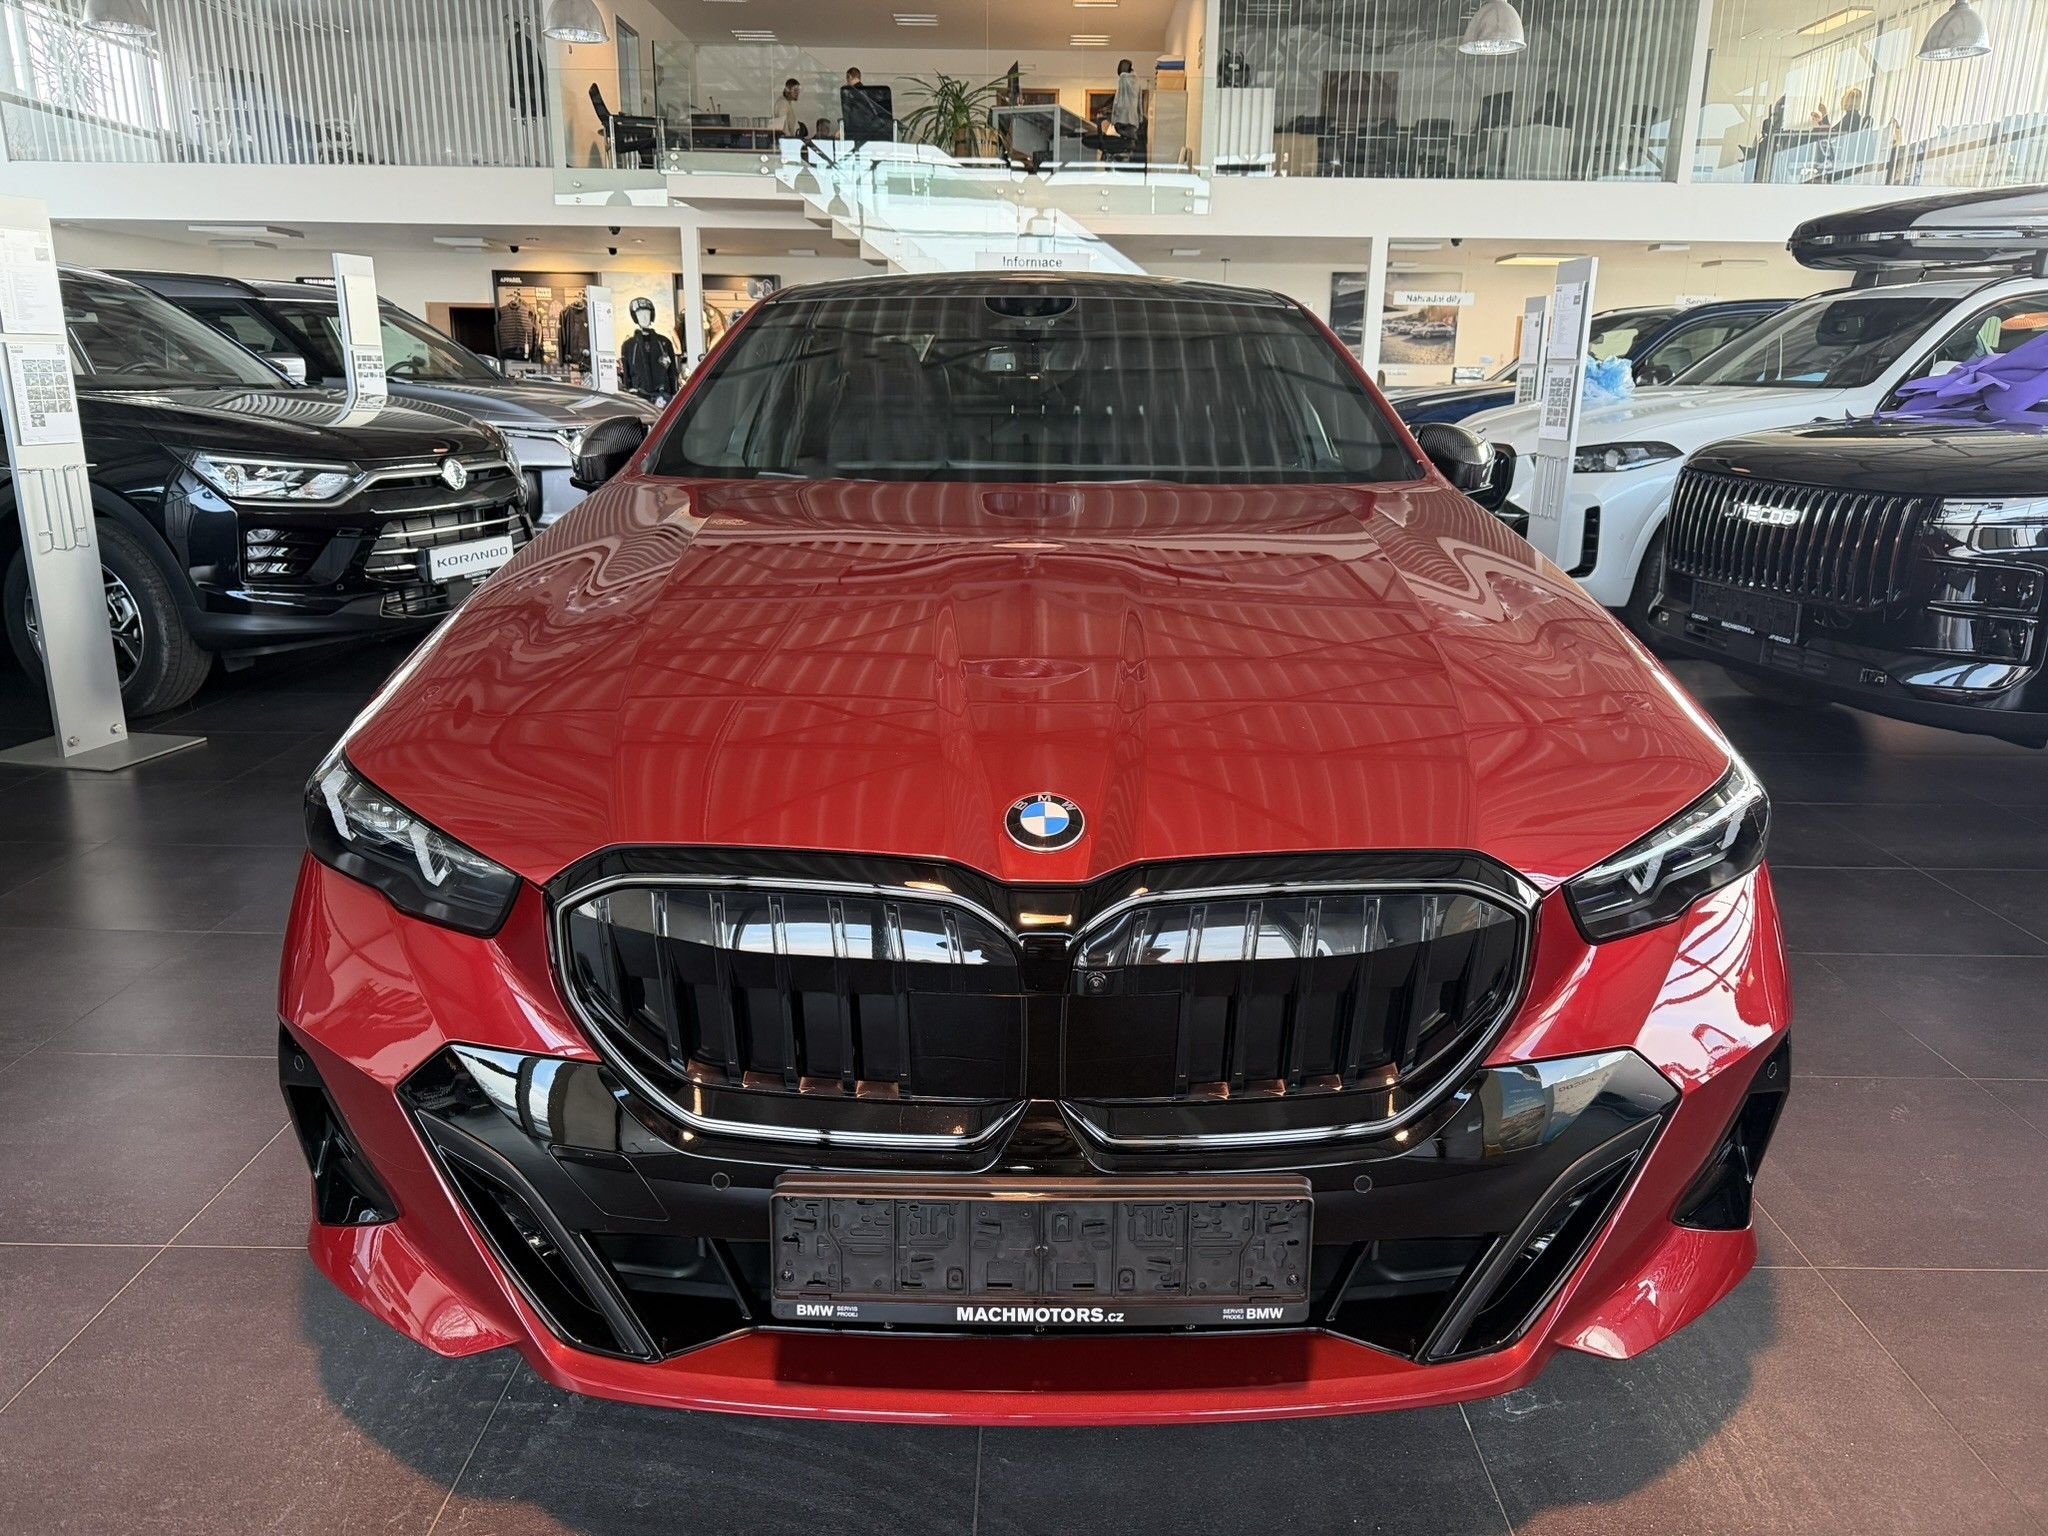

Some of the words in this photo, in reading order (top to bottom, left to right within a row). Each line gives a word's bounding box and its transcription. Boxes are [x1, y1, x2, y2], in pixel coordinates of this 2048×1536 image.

[1002, 256, 1063, 268] Informace
[437, 546, 508, 567] KORANDO
[1013, 795, 1077, 811] BMW
[797, 1305, 834, 1316] BMW
[957, 1307, 1124, 1322] MACHMOTORS.cz
[1246, 1308, 1284, 1319] BMW
